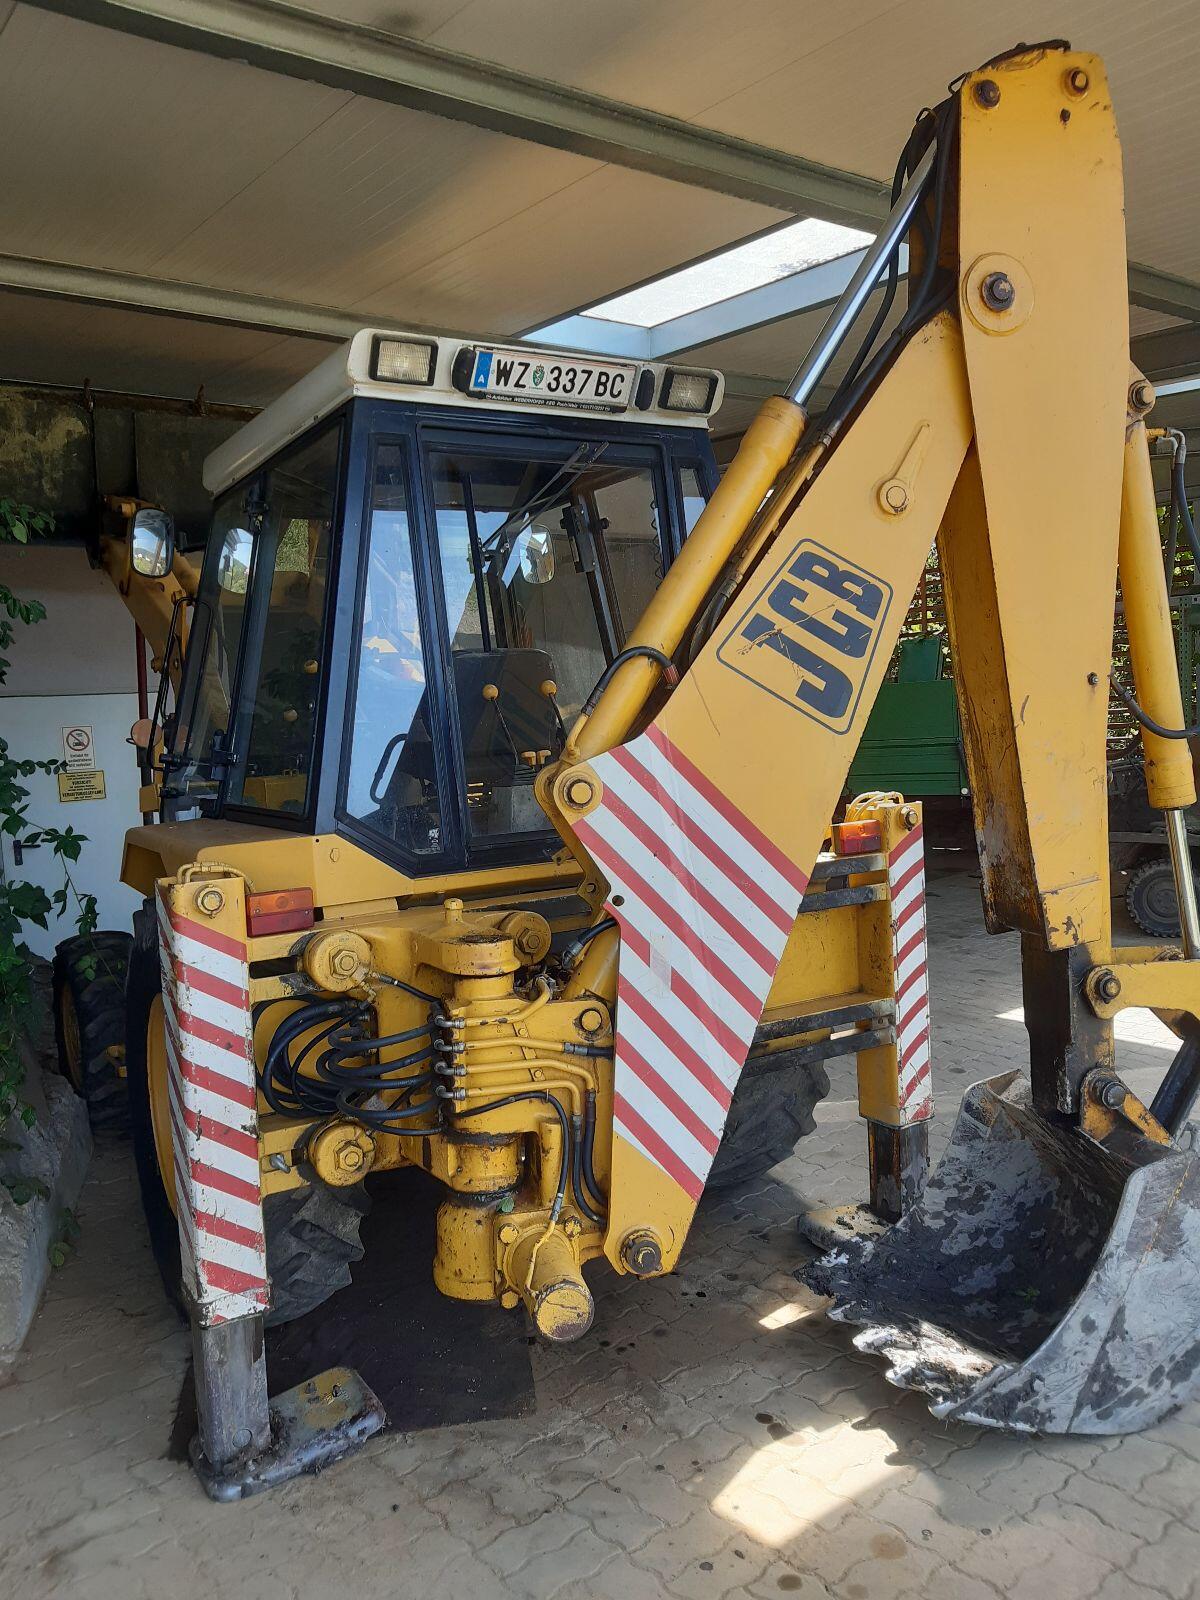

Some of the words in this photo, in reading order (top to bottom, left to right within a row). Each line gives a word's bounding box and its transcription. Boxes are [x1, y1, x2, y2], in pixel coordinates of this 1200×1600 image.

[478, 374, 485, 384] A
[495, 359, 531, 389] WZ
[741, 550, 884, 719] JCB
